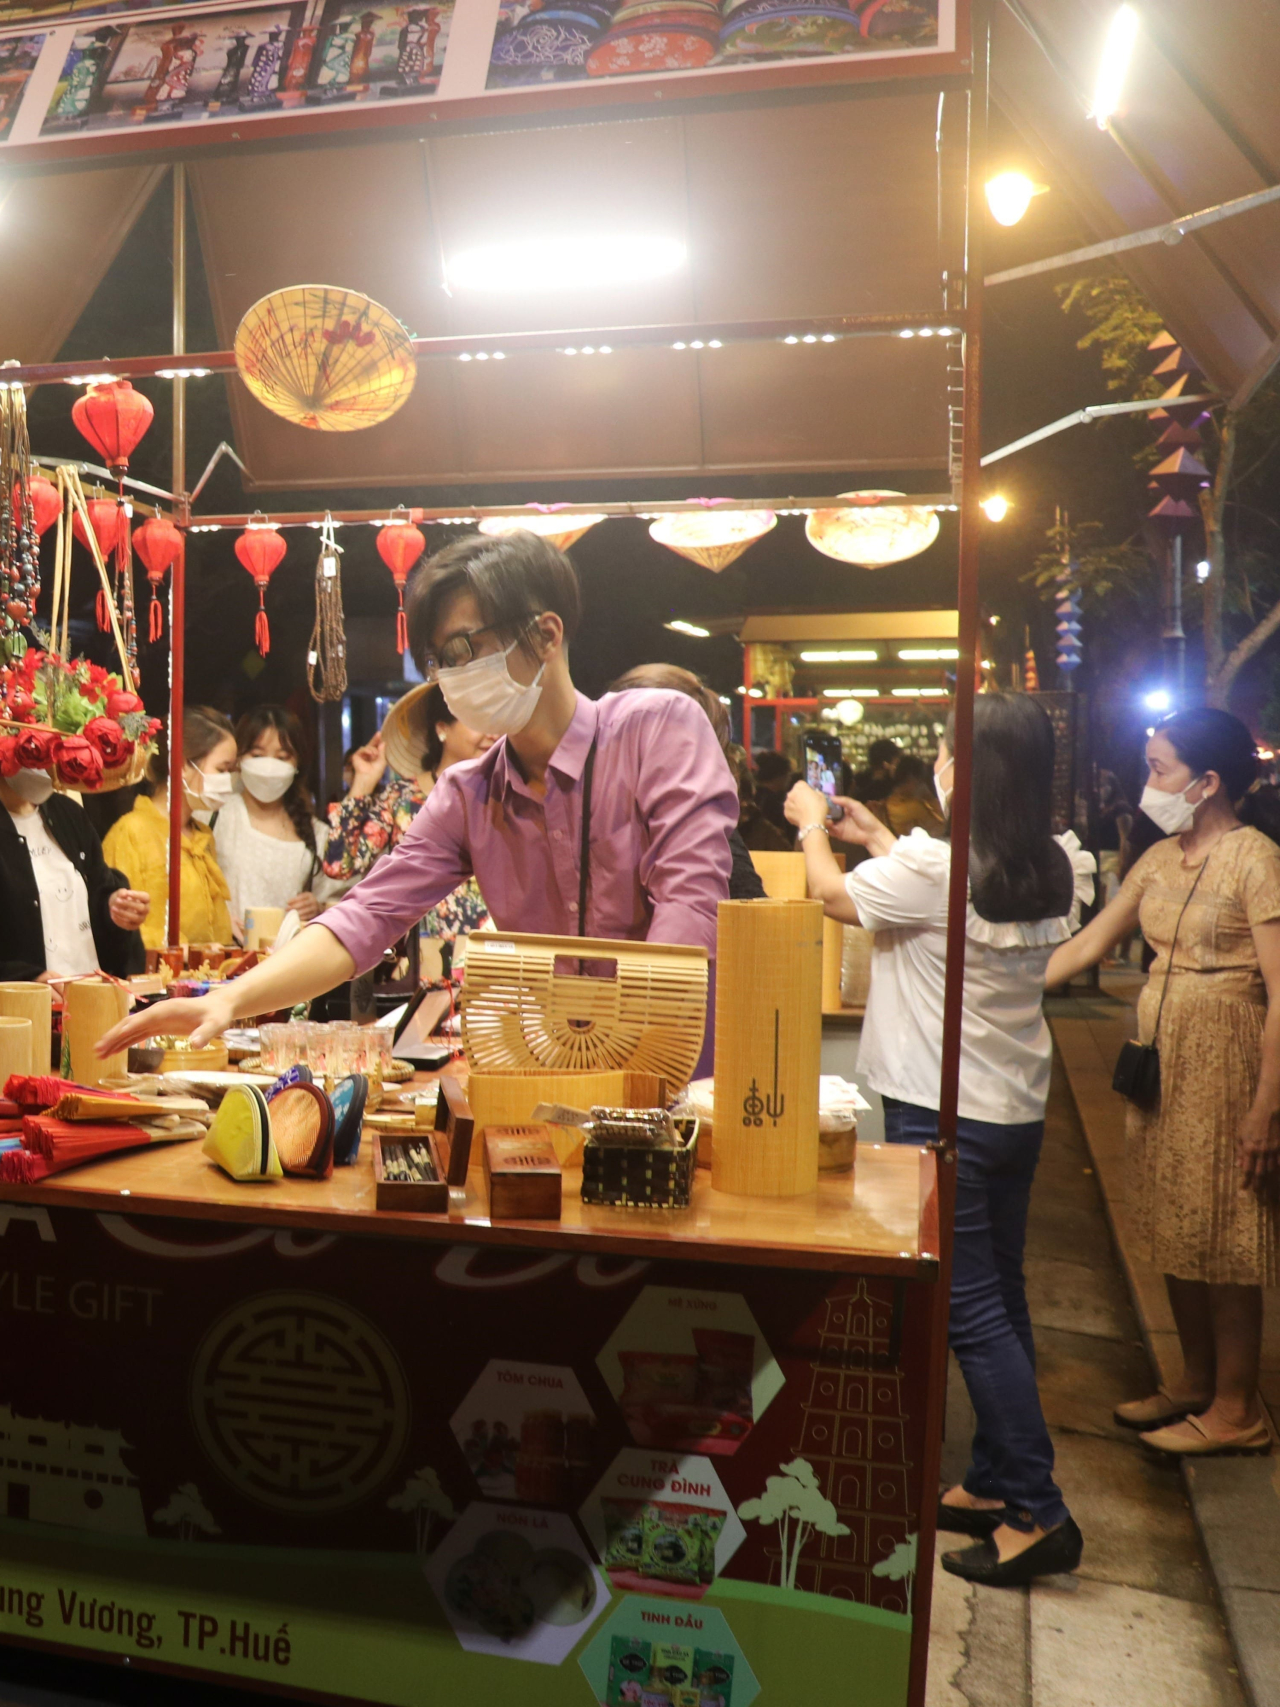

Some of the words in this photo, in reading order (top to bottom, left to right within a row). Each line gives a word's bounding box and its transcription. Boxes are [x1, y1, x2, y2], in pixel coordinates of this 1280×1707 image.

[68, 1280, 163, 1327] GIFT
[528, 1374, 564, 1389] CHUA
[650, 1459, 680, 1475] TRÀ
[617, 1473, 666, 1491] CUNG
[670, 1477, 712, 1497] ĐÌNH
[57, 1587, 163, 1649] Vương,
[177, 1609, 292, 1667] TP.Huế
[640, 1610, 671, 1626] TINH
[674, 1611, 704, 1630] DẦU
